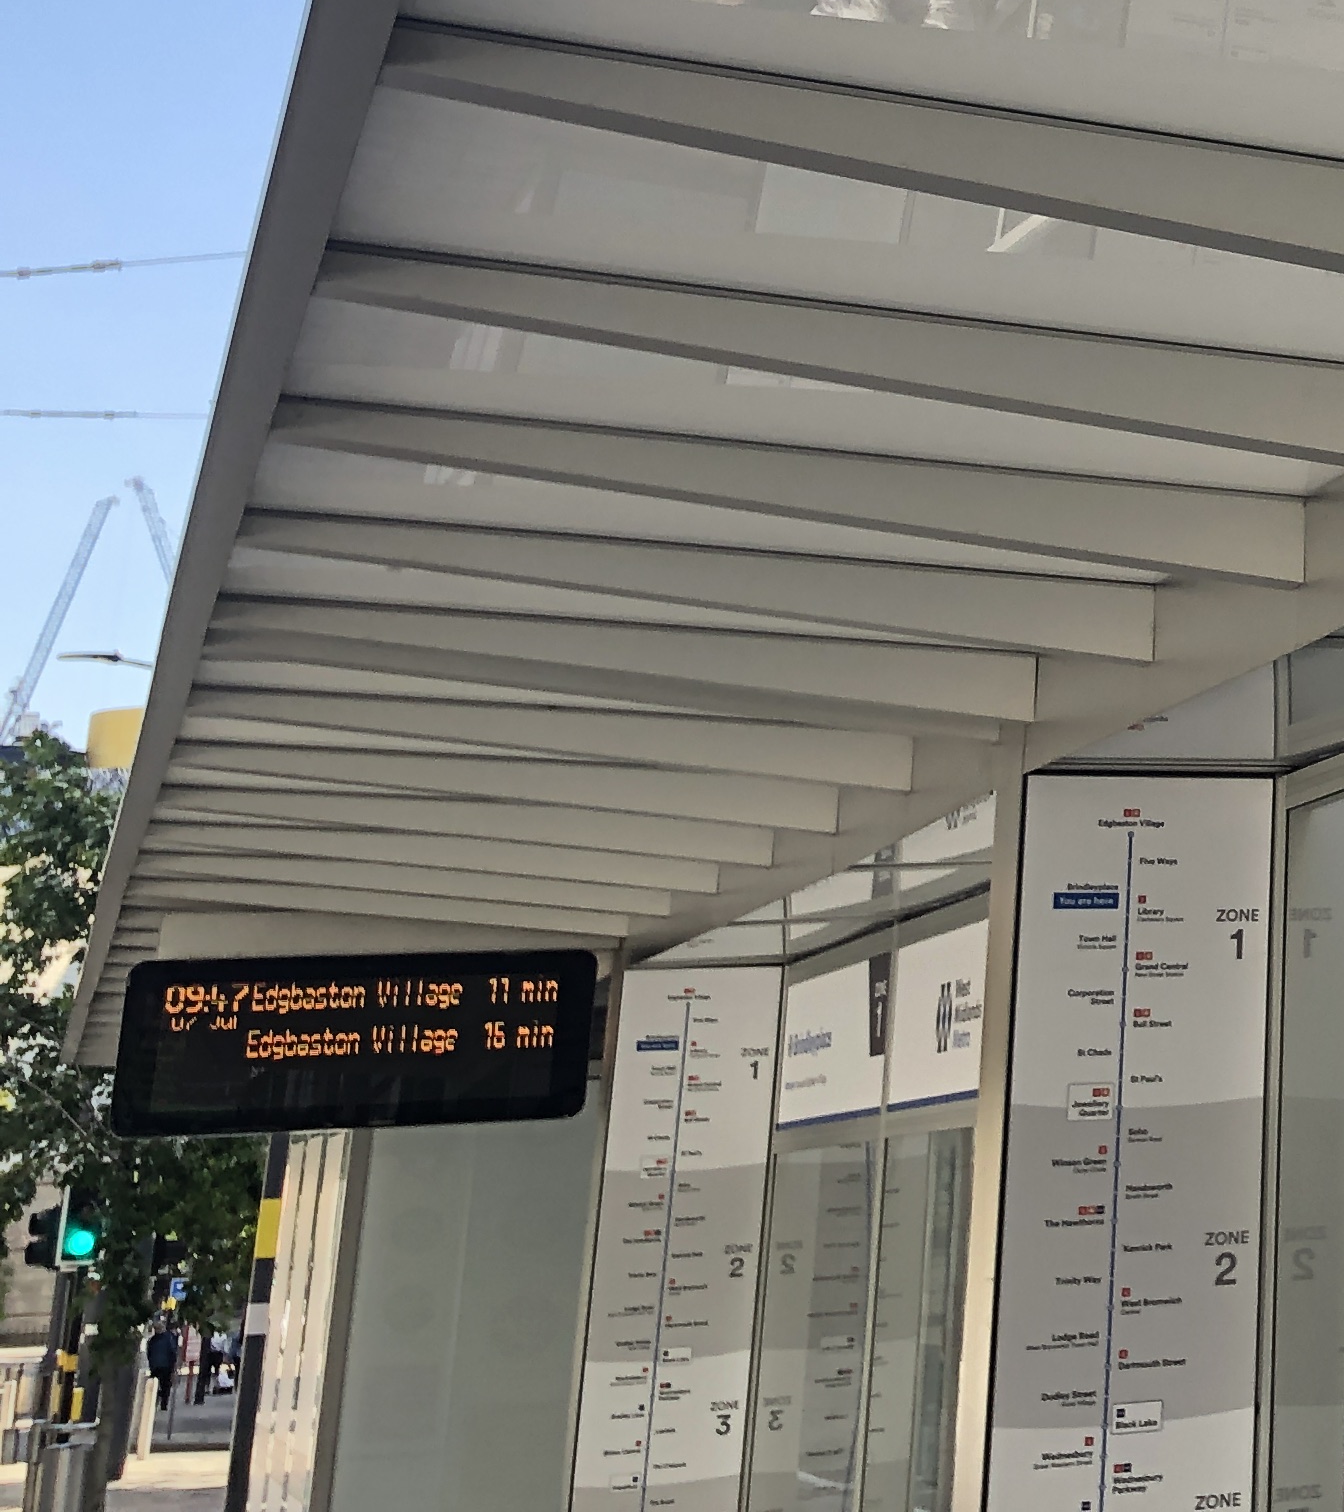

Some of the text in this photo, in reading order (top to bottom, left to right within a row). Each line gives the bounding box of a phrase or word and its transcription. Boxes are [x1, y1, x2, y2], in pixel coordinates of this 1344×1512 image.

[1216, 909, 1259, 922] ZONE
[1230, 929, 1244, 959] 1
[165, 984, 250, 1014] 09:47
[251, 981, 366, 1014] Edgbaston
[377, 977, 463, 1009] Village
[521, 974, 558, 1003] min
[246, 1027, 360, 1060] Edgbaston
[373, 1024, 459, 1056] Village
[516, 1020, 554, 1048] min
[1204, 1230, 1249, 1246] ZONE
[1215, 1251, 1237, 1286] 2
[1194, 1492, 1241, 1510] ZONE
